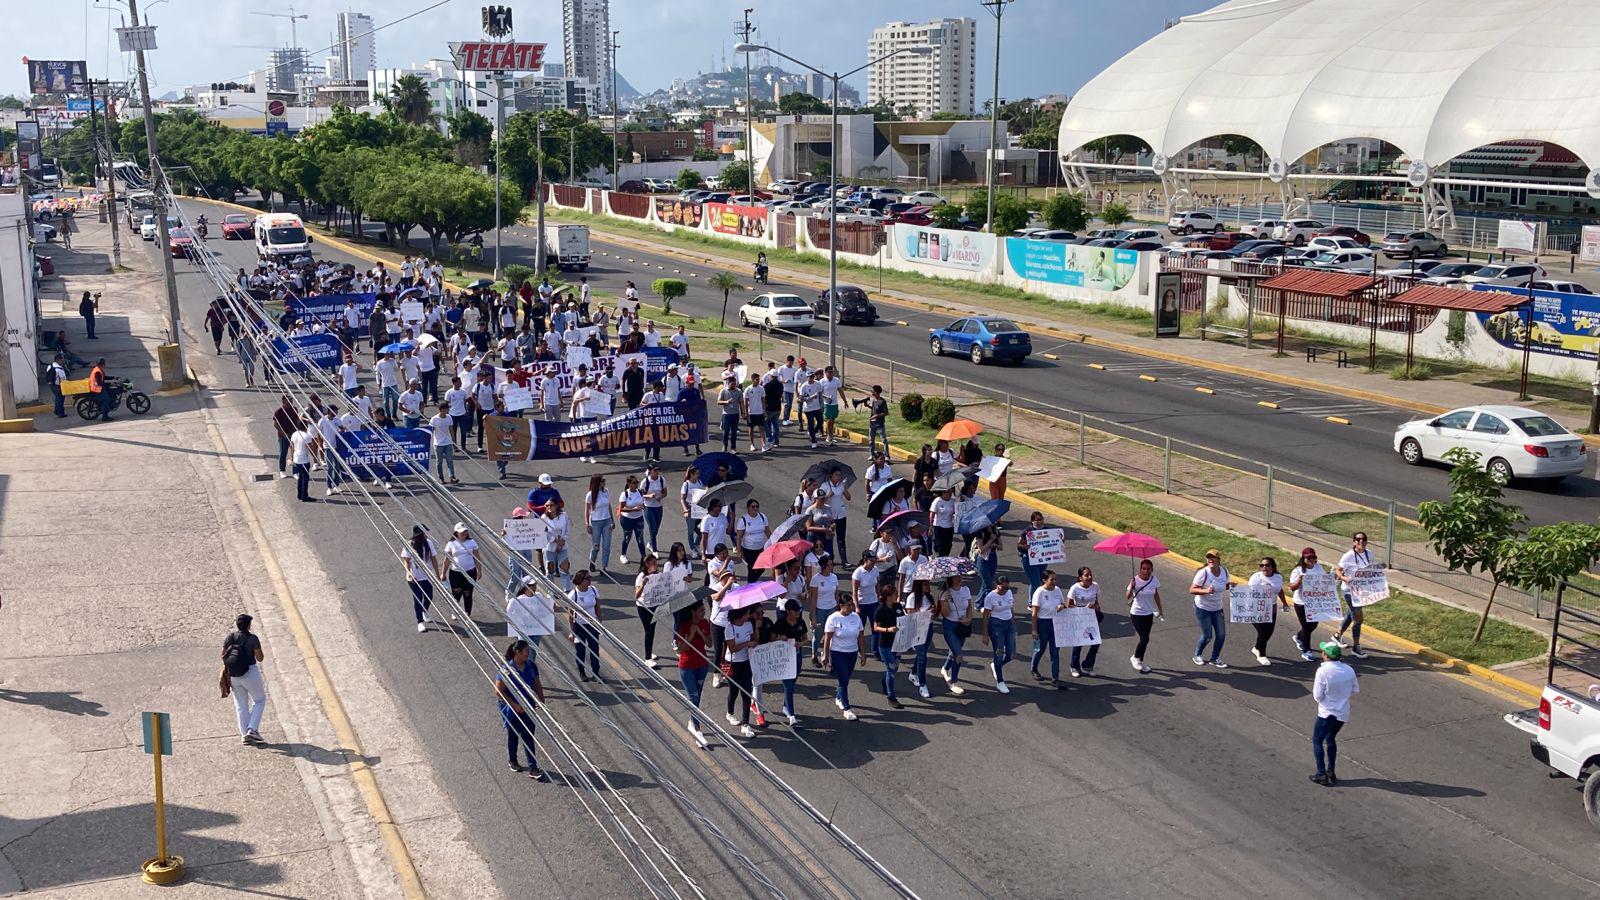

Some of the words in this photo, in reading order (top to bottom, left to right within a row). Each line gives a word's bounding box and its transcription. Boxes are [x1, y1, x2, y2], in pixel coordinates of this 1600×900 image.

[461, 42, 544, 69] TECATE
[570, 425, 588, 433] ALTO
[638, 407, 662, 417] PODER
[663, 406, 676, 415] DEL
[602, 424, 615, 432] DEL
[617, 419, 643, 430] ESTADO
[644, 417, 654, 425] DE
[656, 414, 685, 425] SINALOA
[595, 430, 631, 451] VIVA
[635, 426, 655, 445] LA
[662, 422, 697, 442] UAS"
